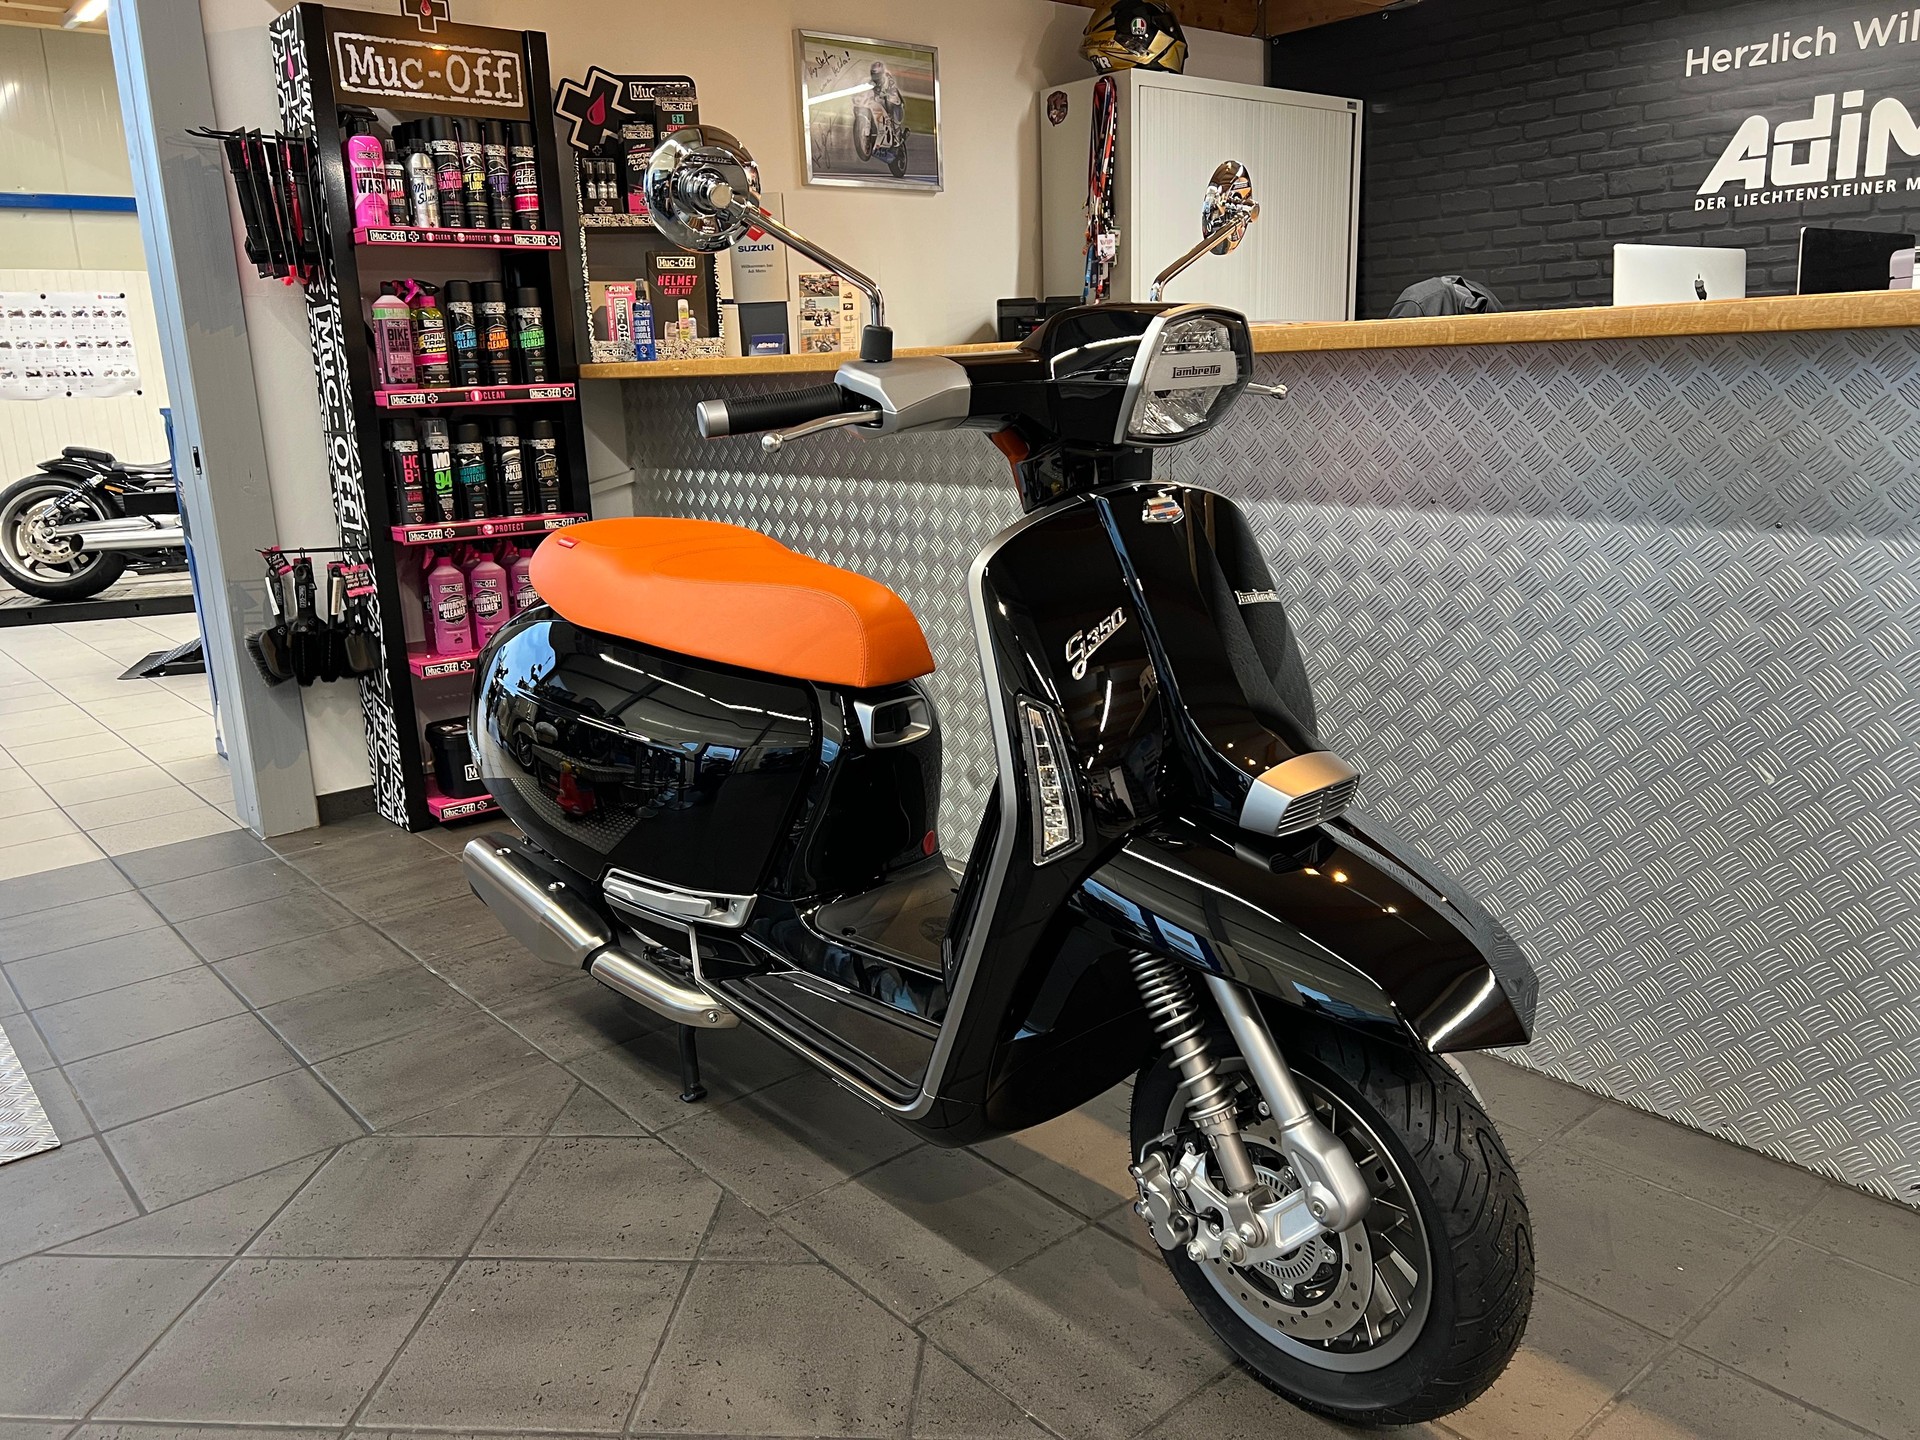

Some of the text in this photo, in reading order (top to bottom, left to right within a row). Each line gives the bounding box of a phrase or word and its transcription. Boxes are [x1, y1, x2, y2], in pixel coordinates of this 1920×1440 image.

[1685, 26, 1837, 77] Herzlich
[345, 43, 513, 99] Muc-Off
[663, 102, 692, 111] Muc-Off
[673, 115, 683, 123] 3X
[1694, 196, 1727, 211] DER
[1734, 179, 1897, 207] LIECHTENSTEINER
[371, 231, 405, 241] Muc-Off
[515, 235, 546, 245] Muc-Off
[738, 244, 774, 253] SUZUKI
[657, 258, 695, 268] Muc-Off
[657, 275, 698, 286] HELMET
[608, 285, 630, 293] PUNK
[682, 287, 692, 295] KIT
[387, 329, 409, 341] BIKE
[391, 394, 425, 404] Muc-Off
[483, 391, 506, 400] CLEAN
[530, 388, 561, 398] Muc-Off
[316, 316, 361, 528] Muc-Off
[435, 471, 453, 490] 94
[409, 529, 443, 541] Muc-Off
[495, 523, 525, 533] PROTECT
[440, 584, 463, 593] Muc-Off
[425, 662, 459, 676] Muc-Off
[375, 704, 392, 820] uc-Off
[443, 803, 476, 819] Muc-Off
